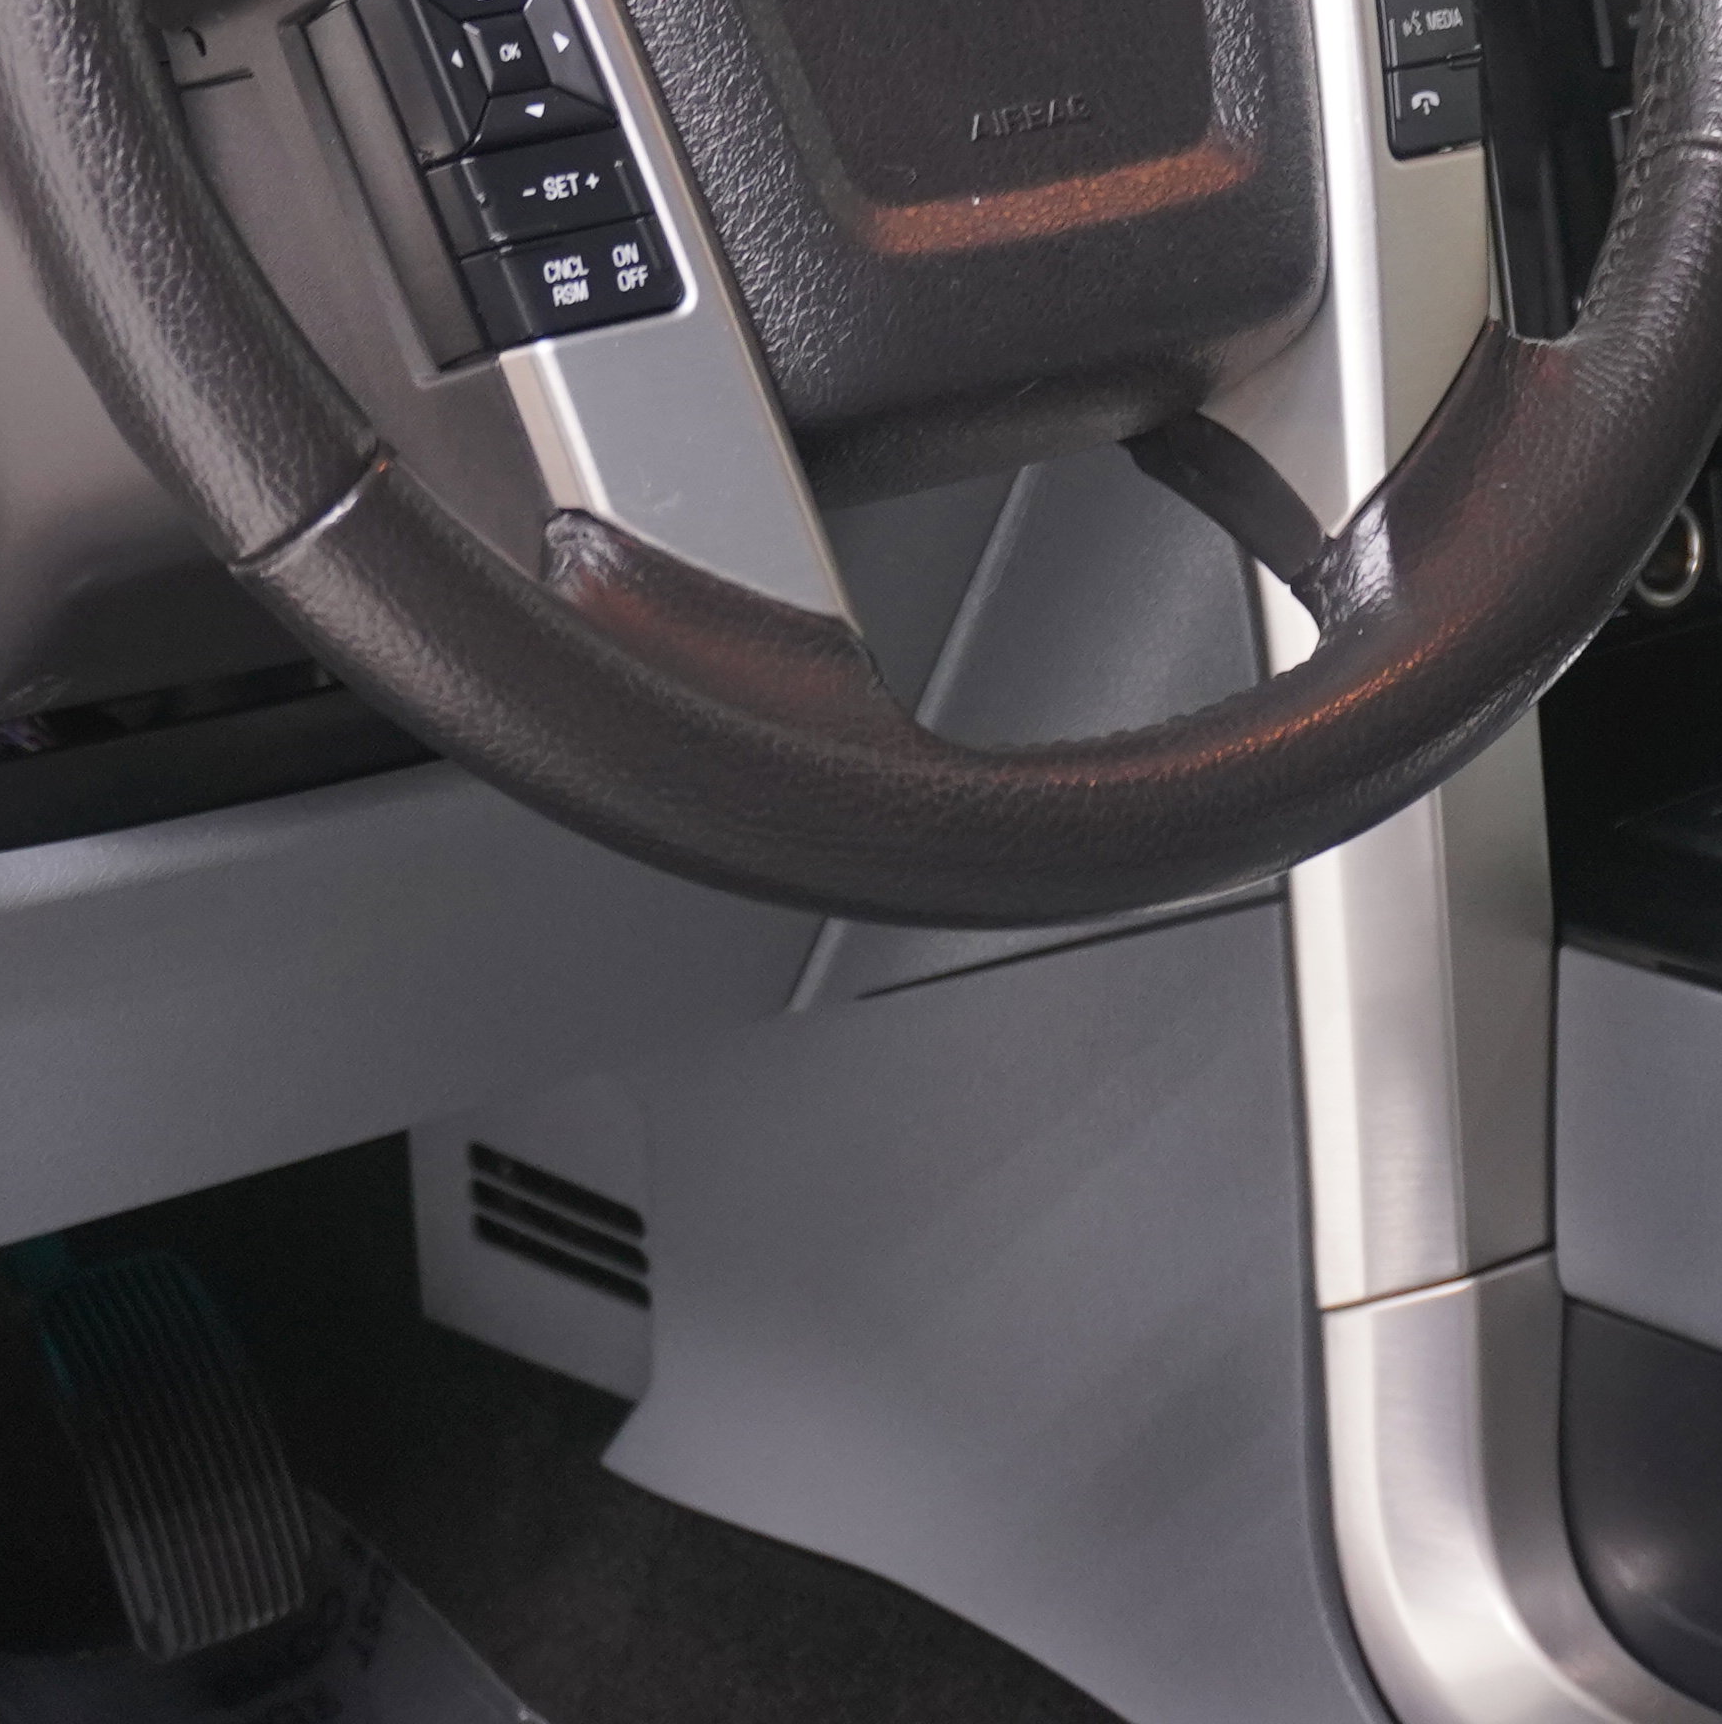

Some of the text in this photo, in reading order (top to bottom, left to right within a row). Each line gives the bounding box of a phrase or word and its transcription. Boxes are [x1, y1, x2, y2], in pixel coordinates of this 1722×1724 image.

[1425, 7, 1464, 31] MEDIA
[499, 42, 521, 62] OK
[542, 172, 580, 201] SET
[612, 242, 639, 268] ON
[543, 255, 590, 284] CNCL
[617, 264, 649, 292] OFF
[552, 279, 589, 307] RSM
